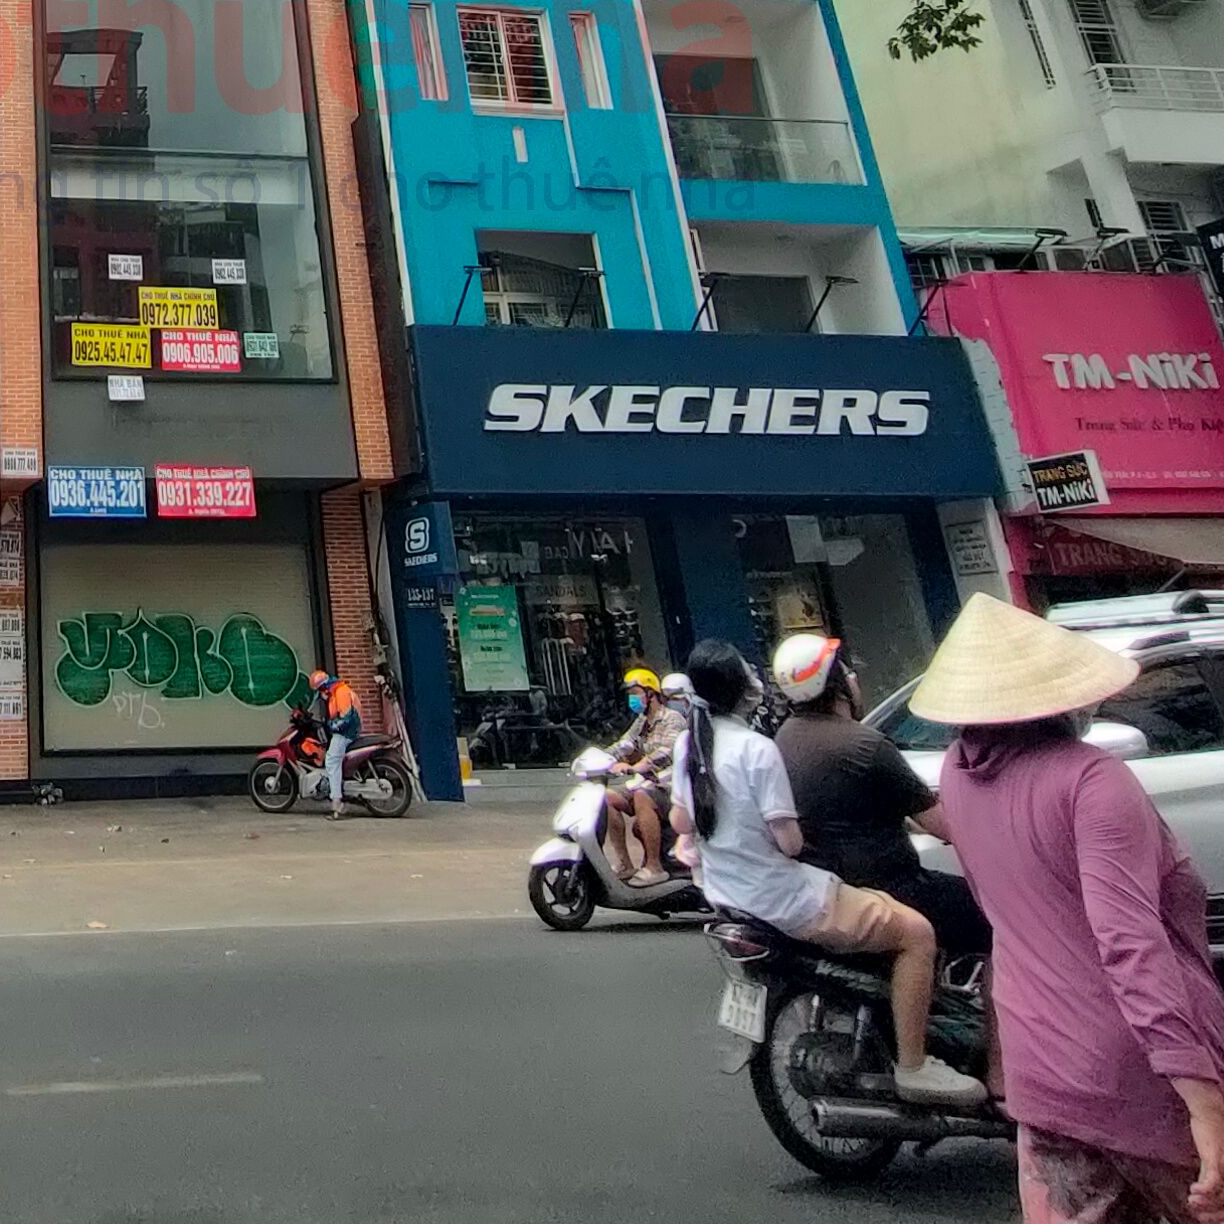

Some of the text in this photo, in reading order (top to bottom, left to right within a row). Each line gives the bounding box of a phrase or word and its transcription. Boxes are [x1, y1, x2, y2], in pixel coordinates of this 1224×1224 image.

[142, 303, 216, 326] 0972.377.039
[74, 328, 96, 338] CHO
[98, 328, 122, 338] THUÊ
[162, 332, 184, 340] CHO
[75, 340, 148, 364] 0925.45.47.47
[163, 342, 240, 364] 0906.905.006
[483, 383, 931, 437] SKECHERS
[51, 468, 144, 480] CHO THUÊ NHÀ
[1034, 465, 1065, 484] TRANG
[52, 480, 144, 507] 0936.445.201
[158, 481, 251, 507] 0931.339.227
